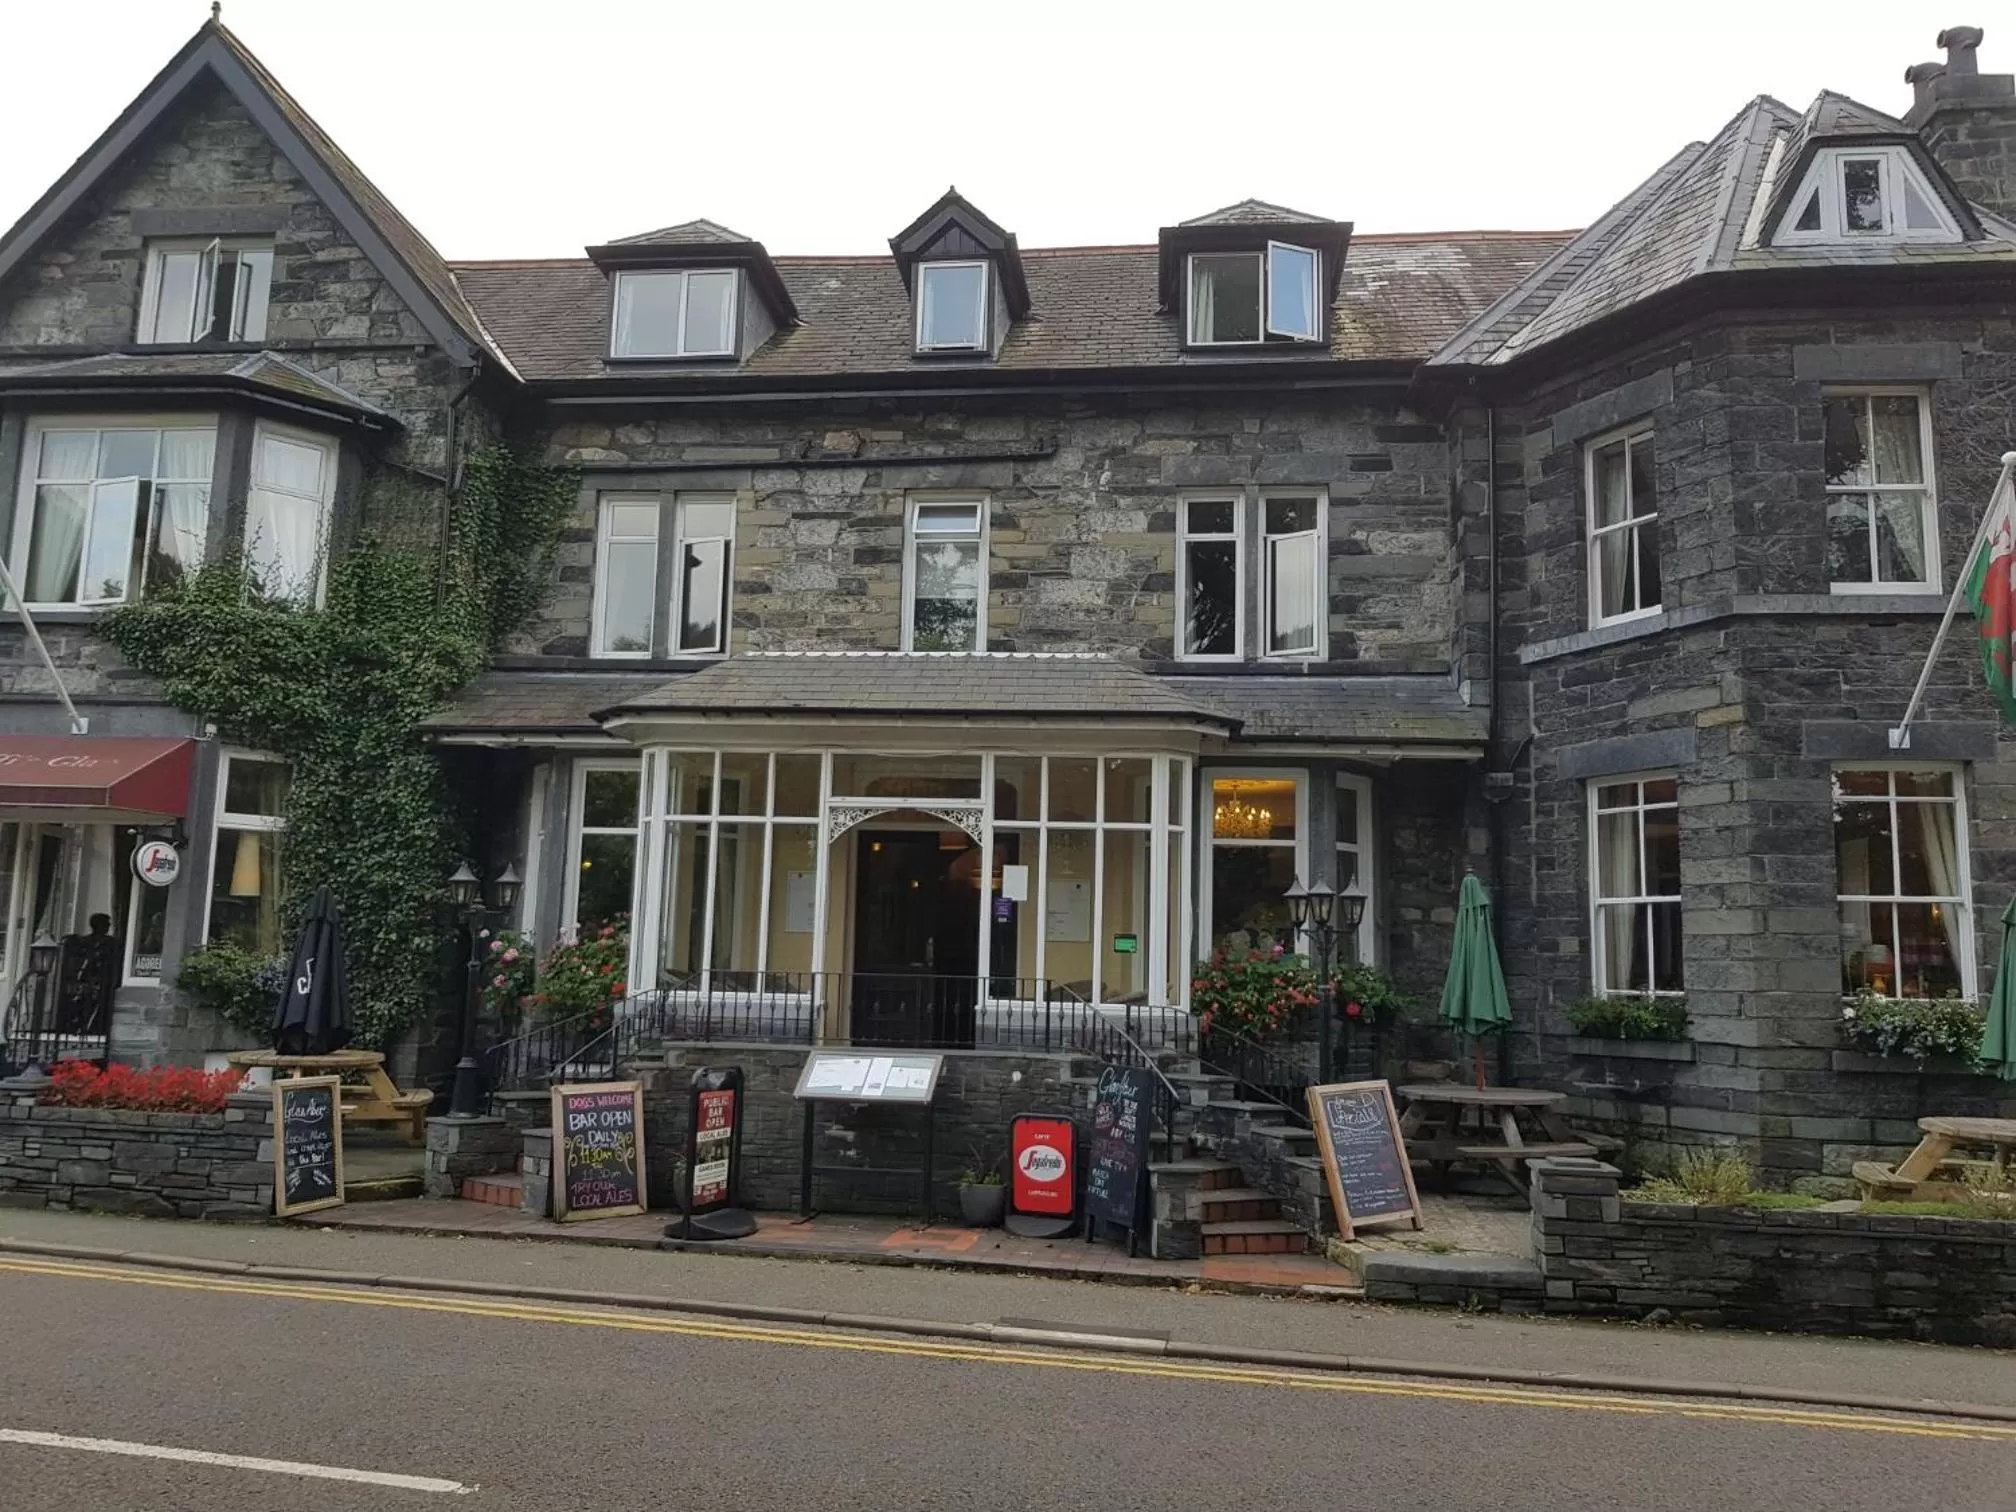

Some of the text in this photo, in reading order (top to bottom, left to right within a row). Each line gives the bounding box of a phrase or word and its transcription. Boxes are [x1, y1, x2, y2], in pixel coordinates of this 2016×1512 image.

[569, 1111, 632, 1131] BAR OPEN
[588, 1130, 619, 1145] DAILY
